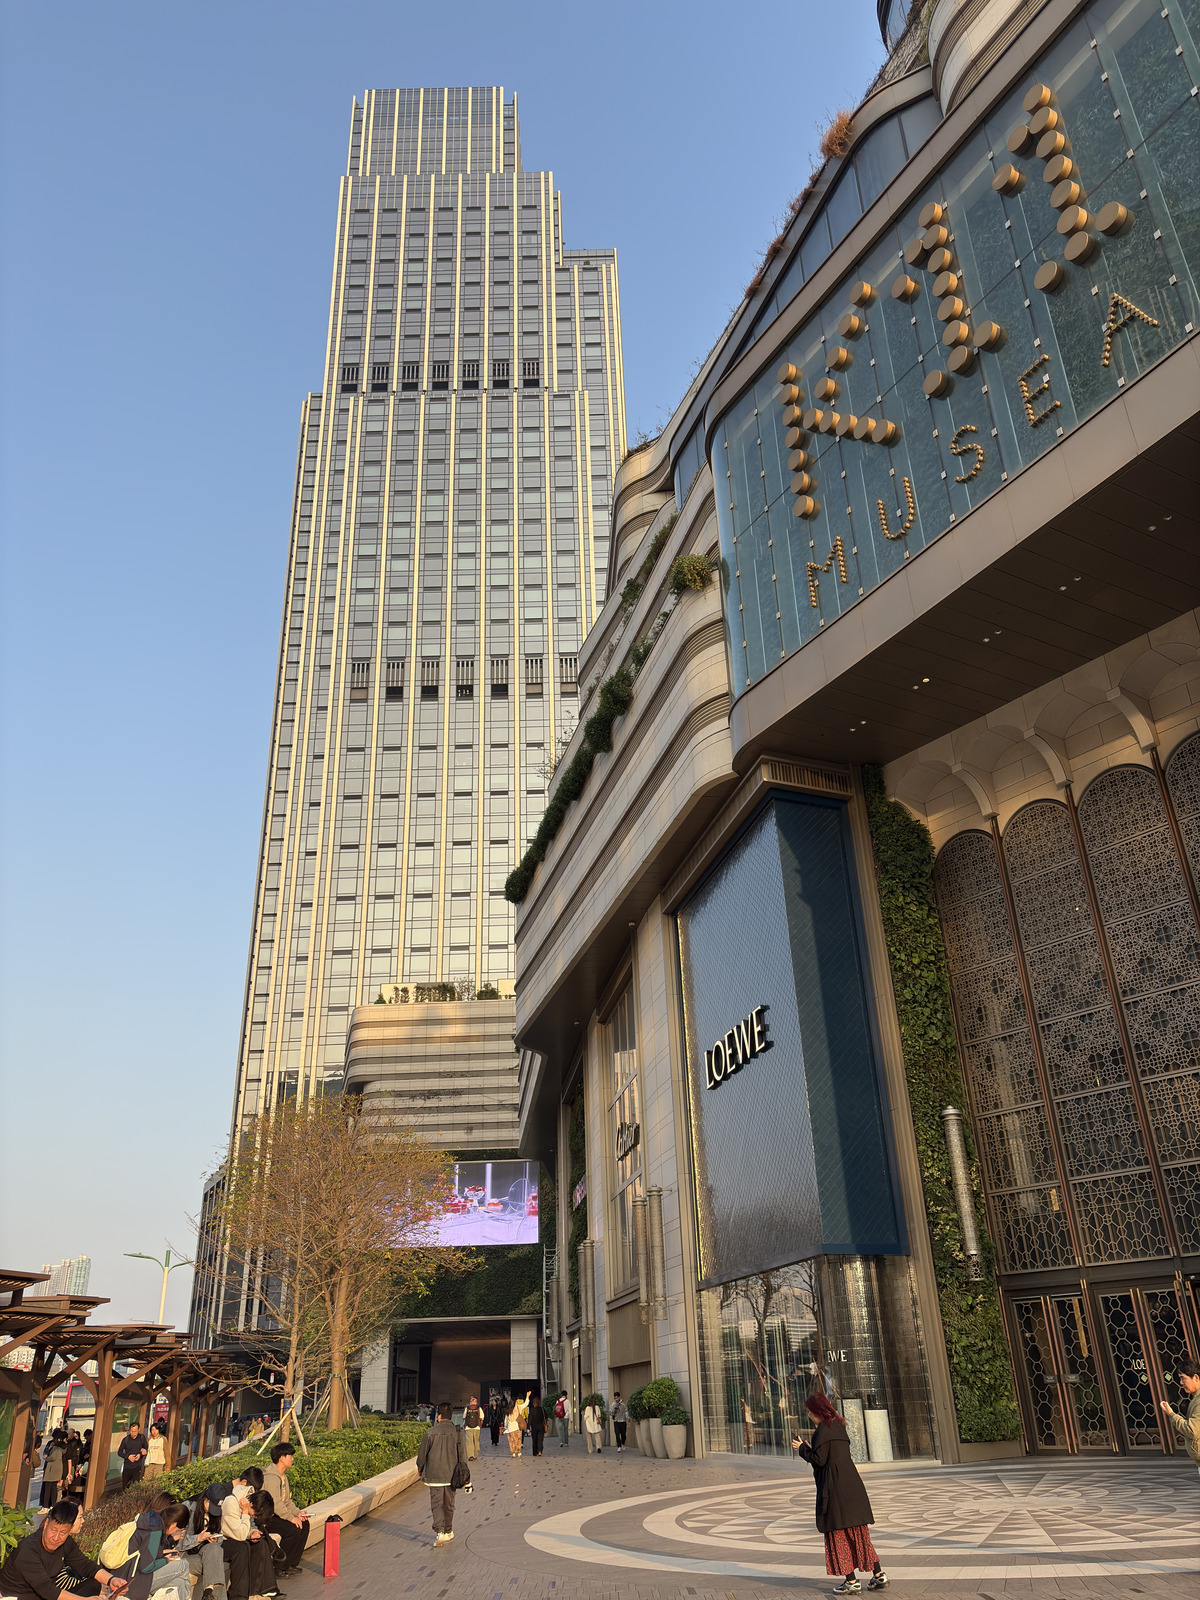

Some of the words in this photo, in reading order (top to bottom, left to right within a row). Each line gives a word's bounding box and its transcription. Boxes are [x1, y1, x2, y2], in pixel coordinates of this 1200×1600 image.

[777, 83, 1134, 520] K11
[806, 293, 1159, 608] MUSEA
[704, 1005, 768, 1090] LOEWE
